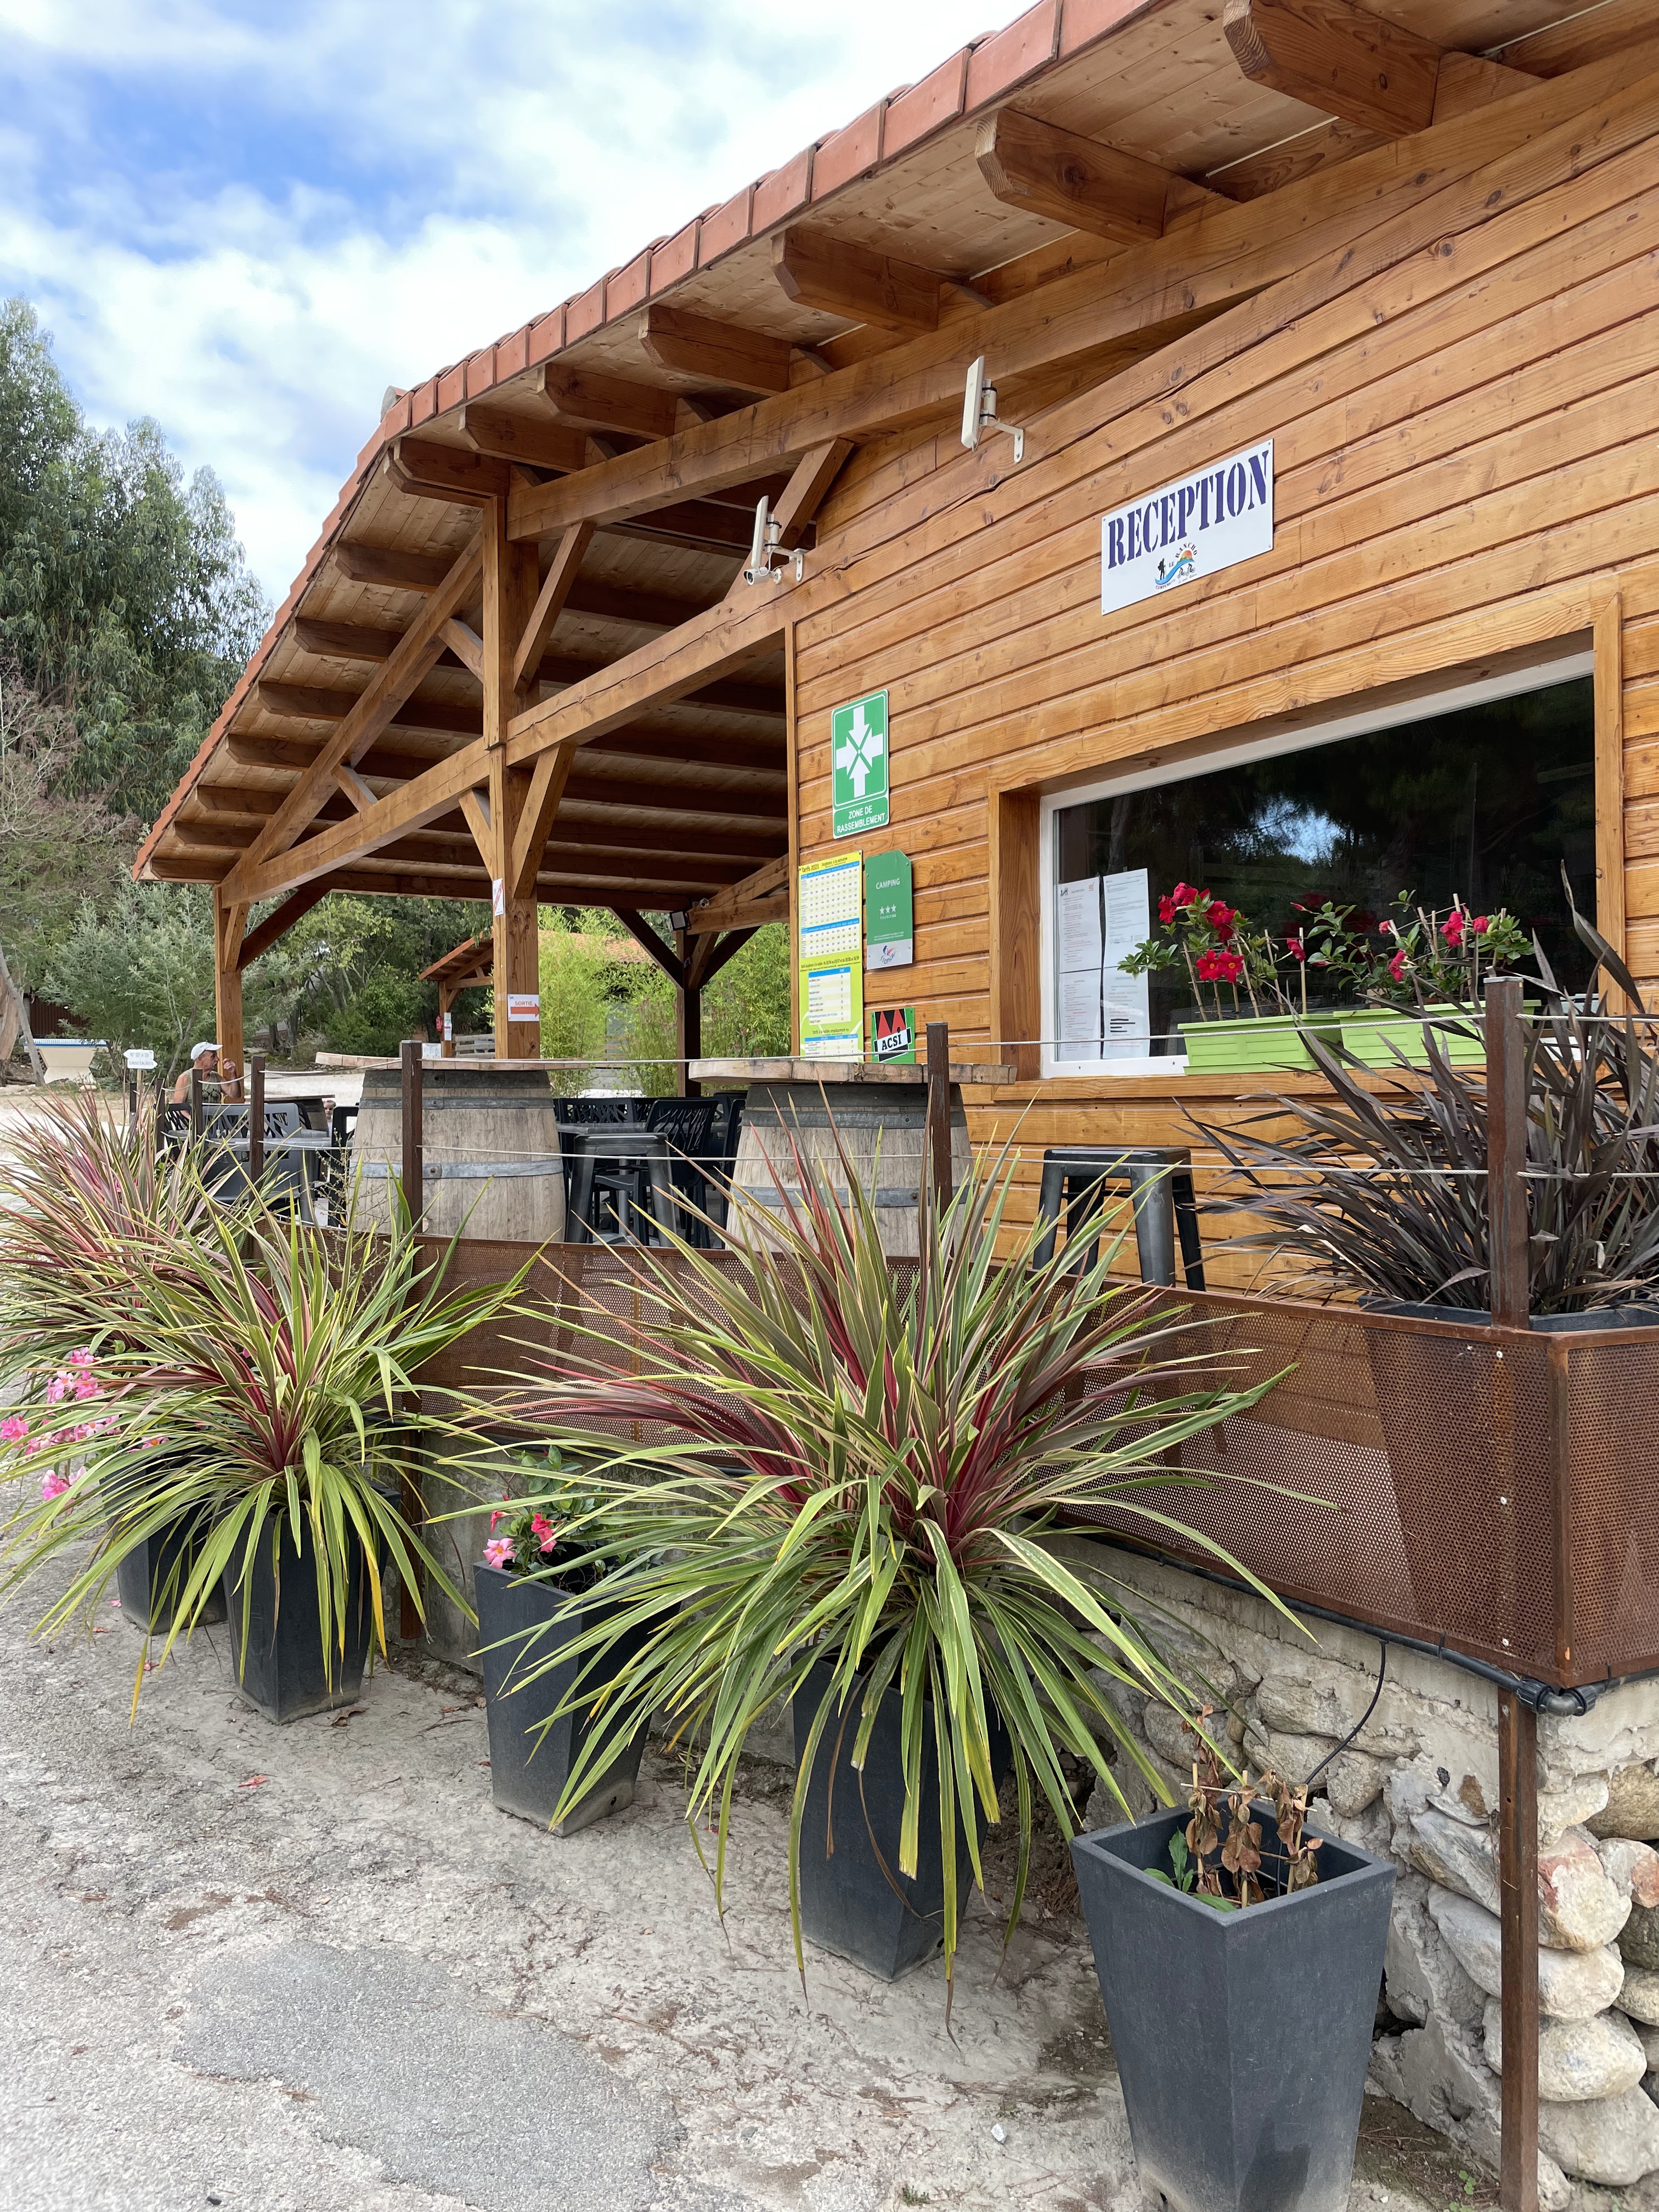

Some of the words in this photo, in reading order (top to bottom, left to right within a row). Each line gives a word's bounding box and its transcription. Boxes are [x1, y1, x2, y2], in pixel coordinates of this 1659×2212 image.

[1108, 450, 1269, 569] RECEPTION
[1175, 543, 1197, 558] RANCHO
[849, 808, 864, 819] ZONE
[865, 805, 872, 814] DE
[837, 813, 885, 833] RASSEMBLEMENT
[876, 878, 900, 889] CAMPING
